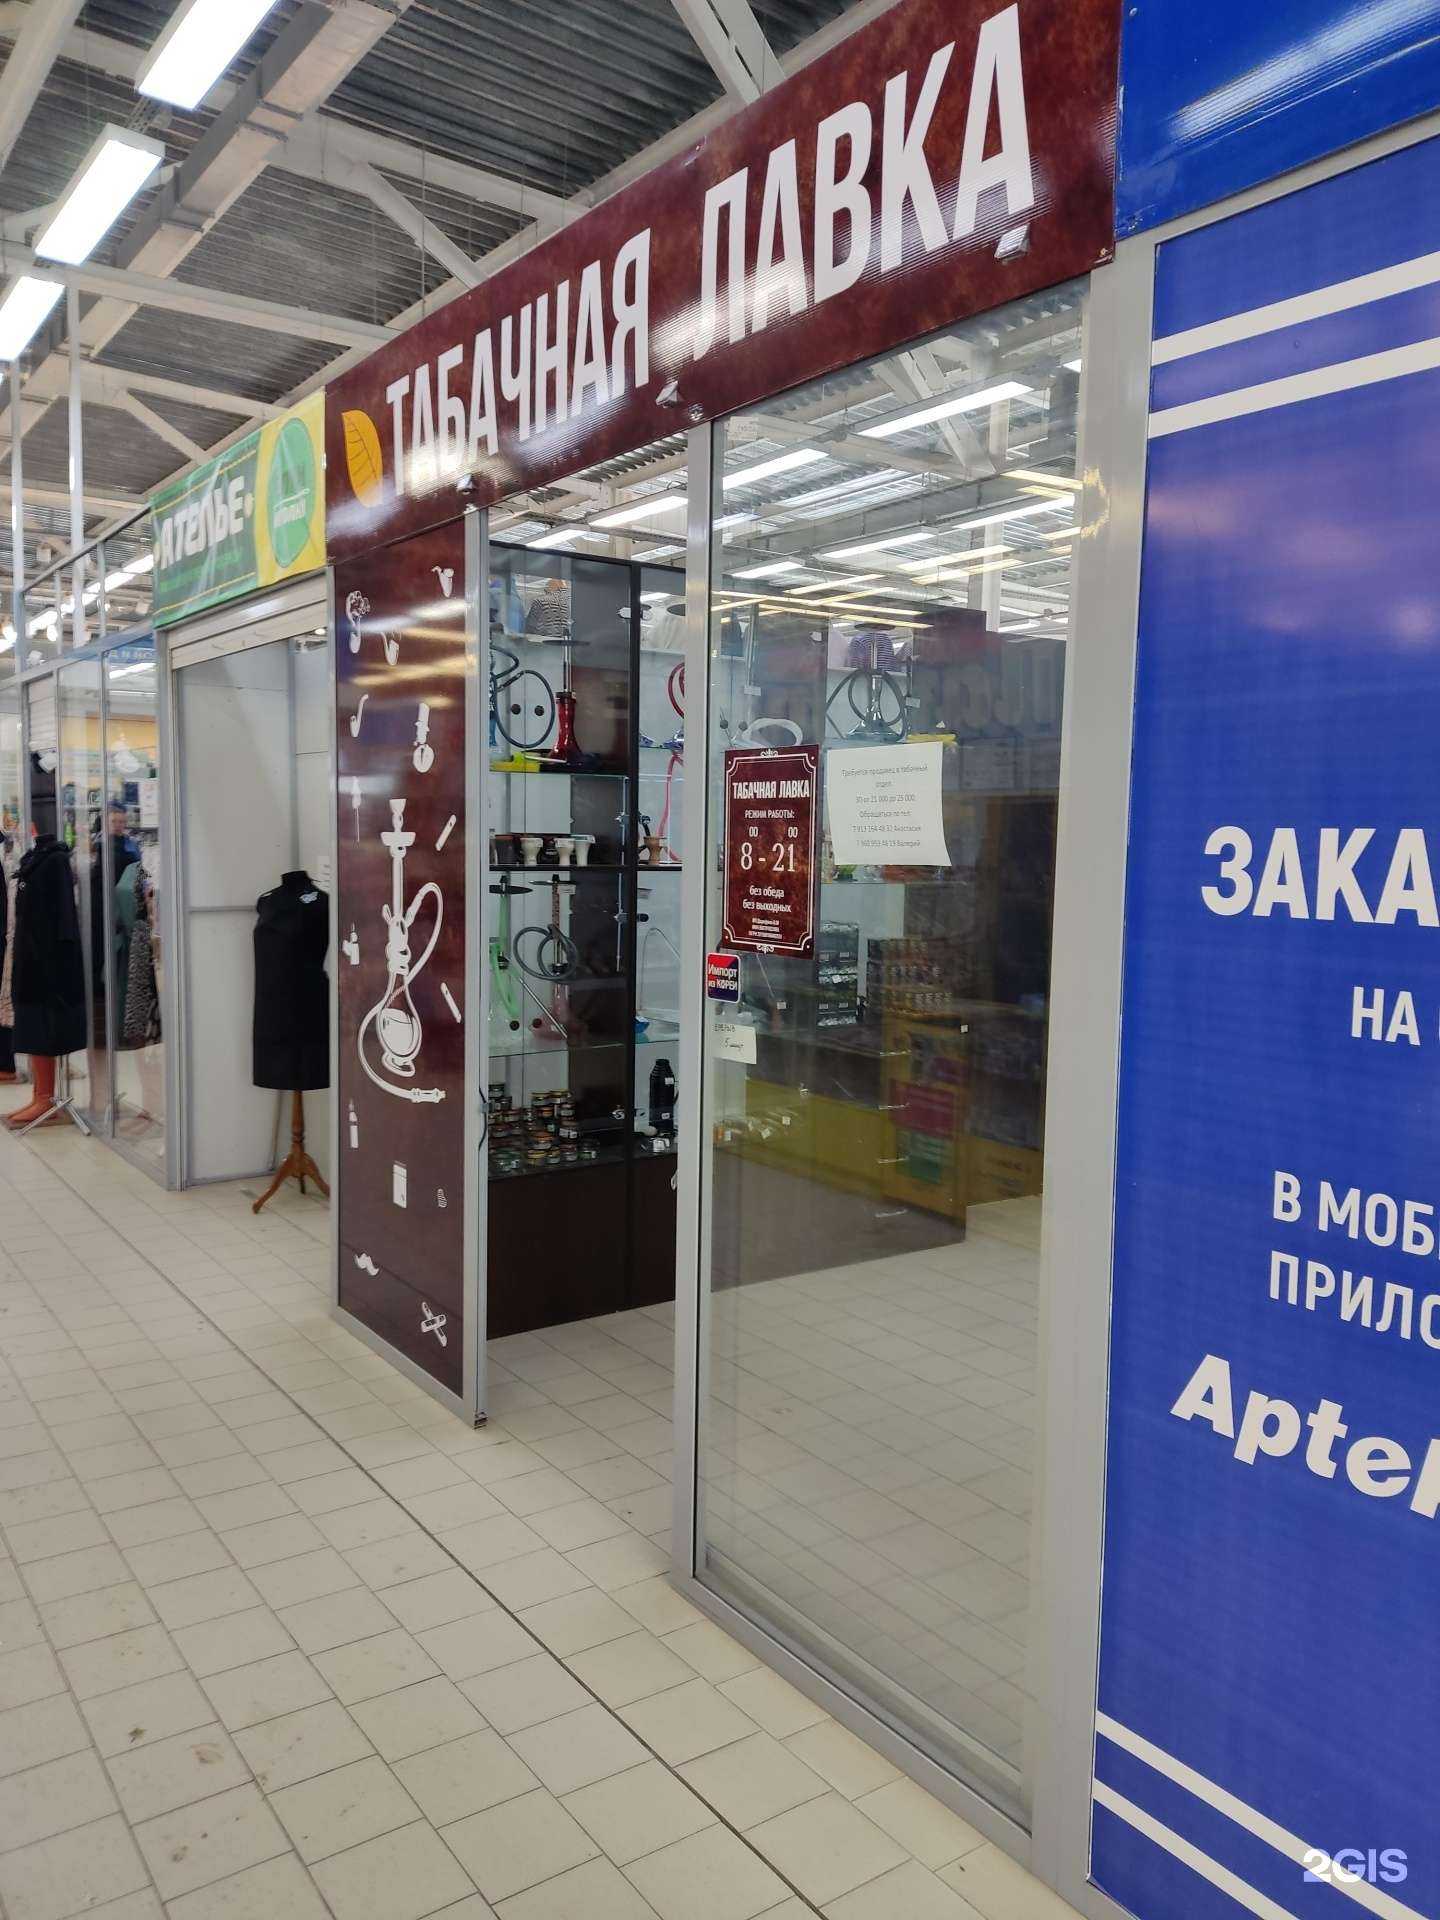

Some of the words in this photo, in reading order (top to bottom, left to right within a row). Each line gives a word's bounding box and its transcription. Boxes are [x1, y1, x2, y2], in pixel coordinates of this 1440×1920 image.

[386, 227, 651, 497] ТАБАЧНАЯ
[693, 2, 1035, 361] ЛАВКА
[160, 476, 245, 571] АТЕЛЬЕ
[732, 781, 777, 799] ТАБАЧНАЯ
[779, 780, 810, 798] ЛАВКА
[745, 809, 767, 819] РЕЖИМ
[768, 809, 795, 819] РАБОТЫ:
[748, 826, 759, 838] 00
[787, 826, 799, 838] 00
[740, 842, 753, 871] 8
[772, 842, 796, 872] 21
[1201, 825, 1440, 927] ЗАКА
[749, 885, 762, 896] без
[763, 886, 785, 899] обеда
[742, 899, 755, 910] без
[756, 901, 792, 914] выходных
[708, 963, 738, 980] Импорт
[1351, 986, 1421, 1046] НА
[1272, 1170, 1302, 1223] В
[1318, 1181, 1440, 1262] МОБ
